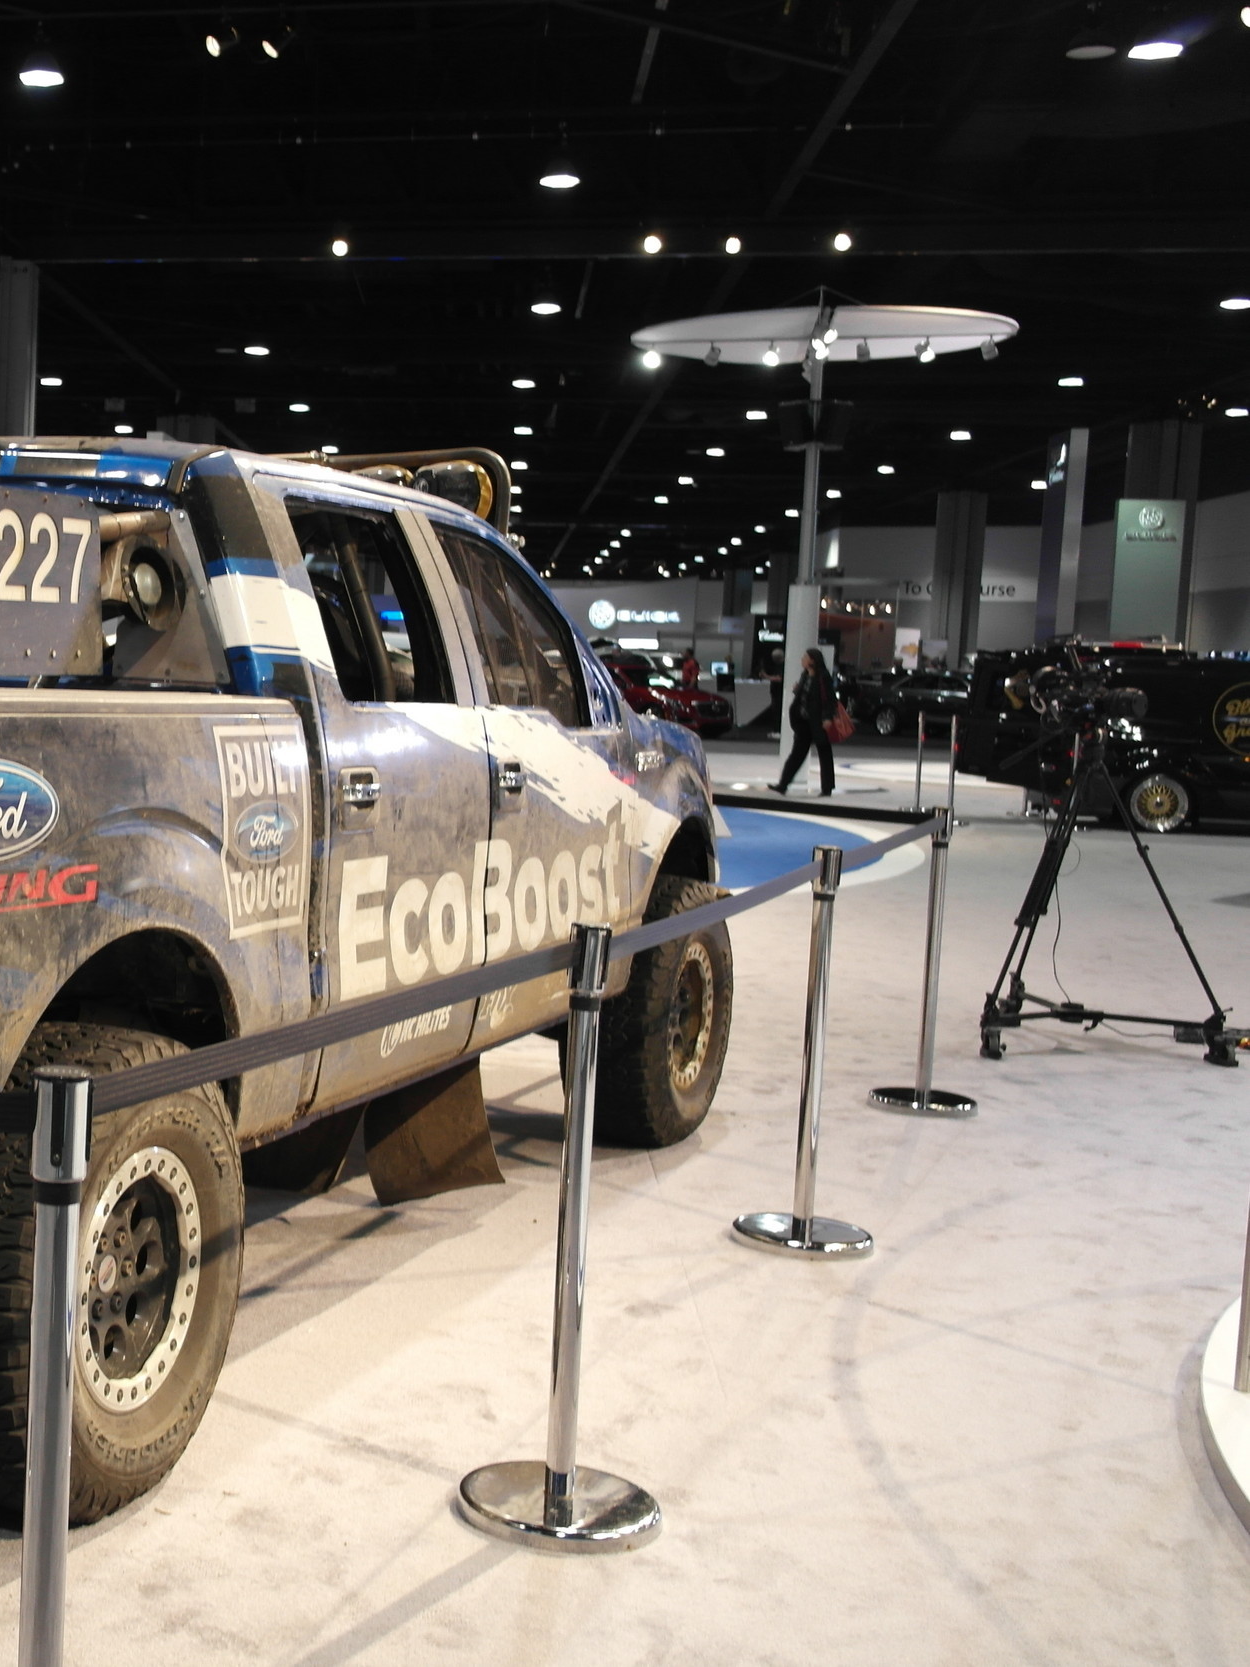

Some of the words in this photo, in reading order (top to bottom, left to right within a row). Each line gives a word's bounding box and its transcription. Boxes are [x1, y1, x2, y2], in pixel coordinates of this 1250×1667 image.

[904, 581, 922, 595] To
[250, 814, 284, 848] Ford
[230, 863, 300, 917] TOUGH
[338, 822, 620, 1002] EcoBoost
